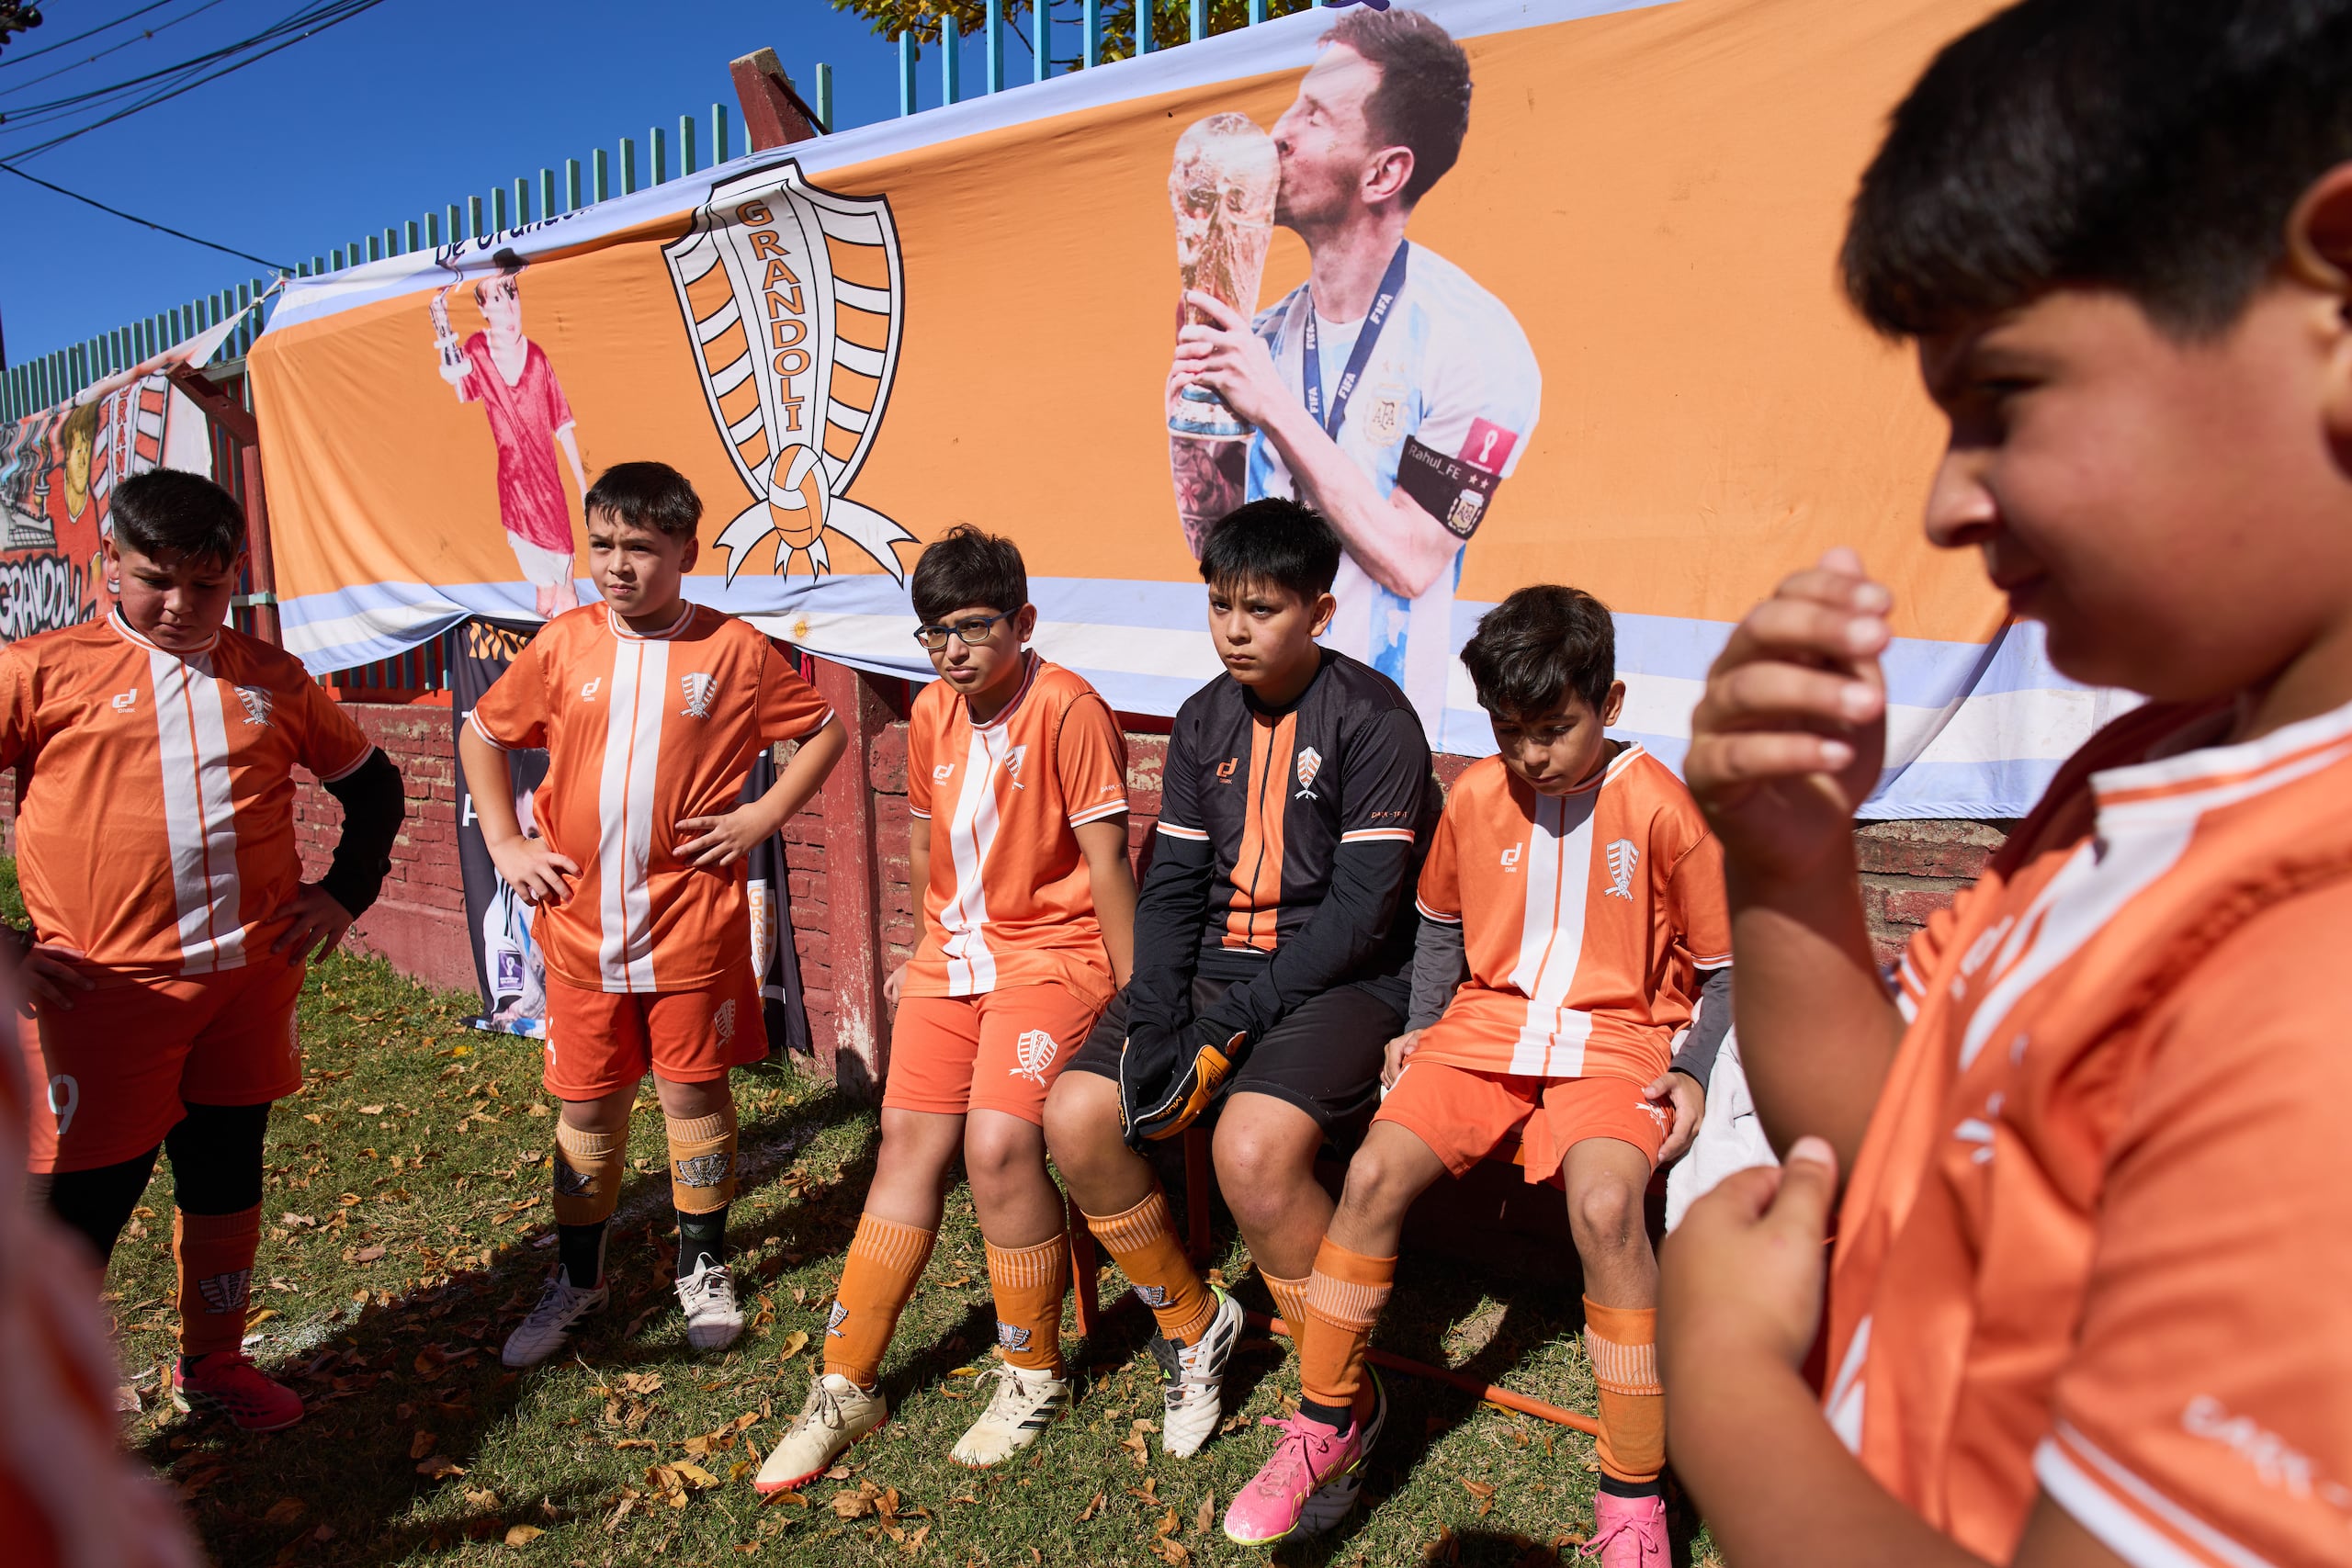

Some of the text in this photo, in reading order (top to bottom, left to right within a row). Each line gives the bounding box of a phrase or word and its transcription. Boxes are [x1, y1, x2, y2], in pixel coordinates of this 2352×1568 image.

[736, 199, 811, 432] GRANDOLI
[1369, 293, 1394, 324] FIFA
[1308, 386, 1318, 413] FIFA
[1338, 373, 1356, 400] FIFA
[1408, 445, 1462, 479] Rahul_FE
[47, 1074, 79, 1134] 9
